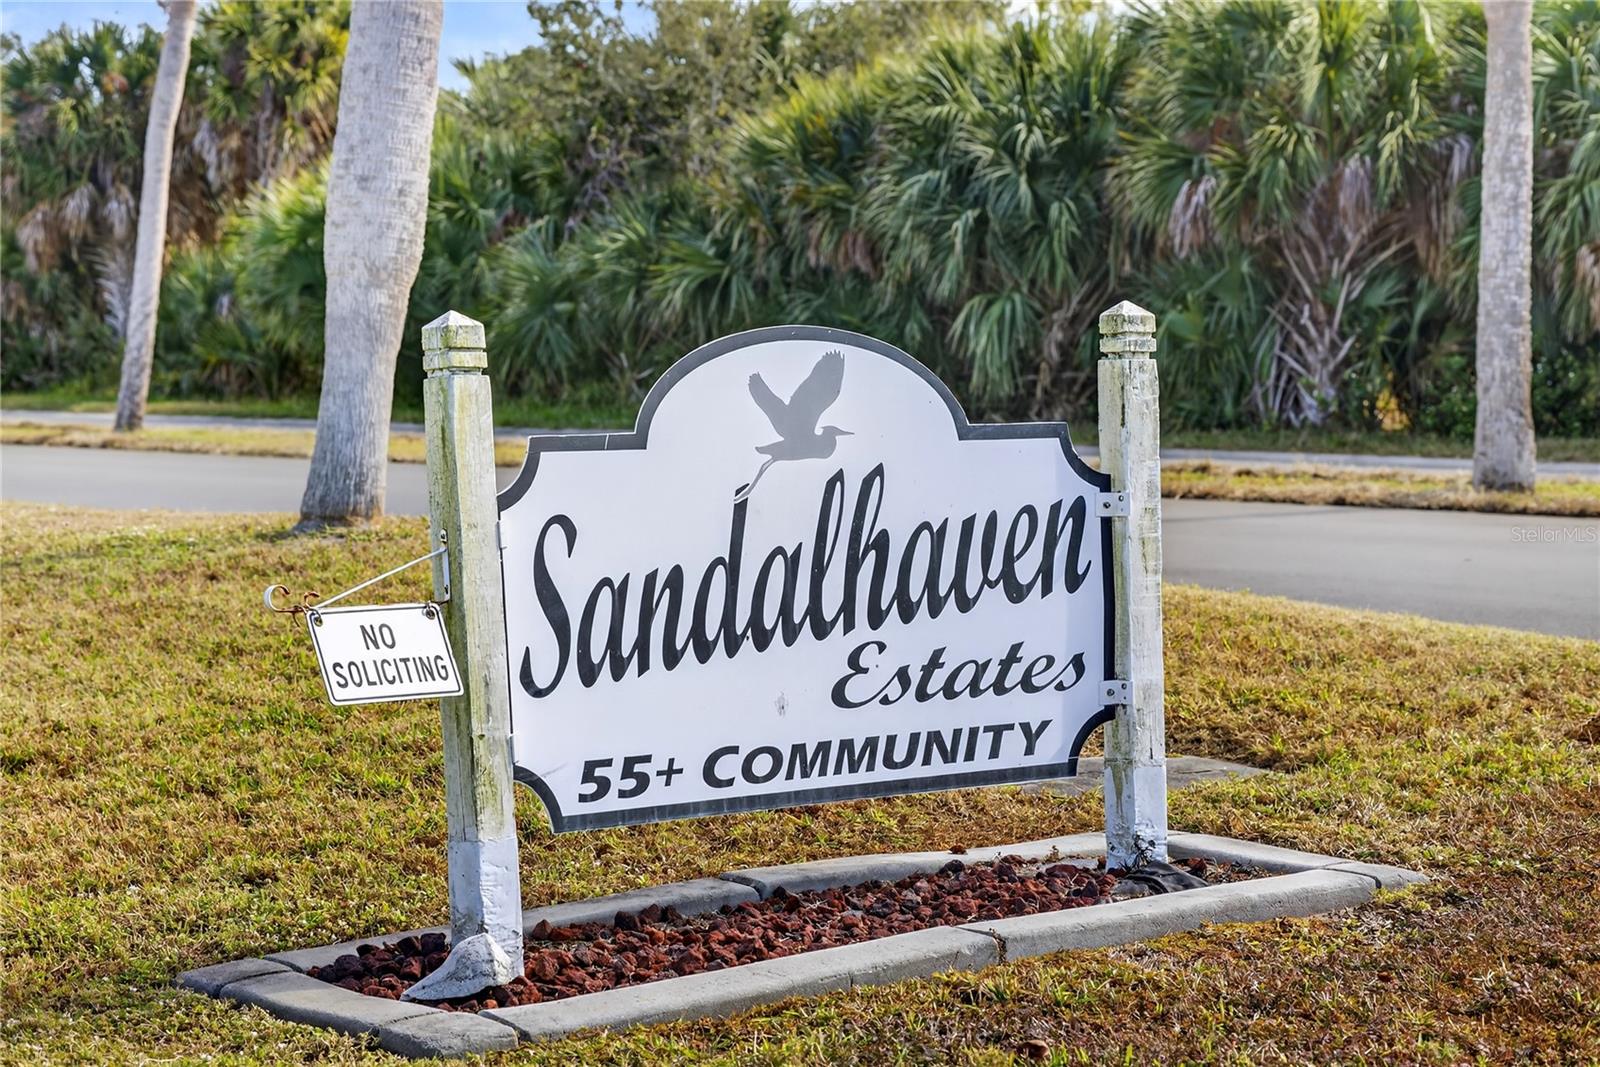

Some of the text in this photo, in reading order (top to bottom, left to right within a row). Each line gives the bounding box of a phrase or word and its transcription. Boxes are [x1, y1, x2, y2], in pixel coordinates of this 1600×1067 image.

[520, 462, 1092, 698] Sandalhaven
[360, 623, 396, 650] NO
[332, 654, 449, 689] SOLICITING
[831, 641, 1086, 709] Estates
[578, 719, 1054, 804] 55+ COMMUNITY
